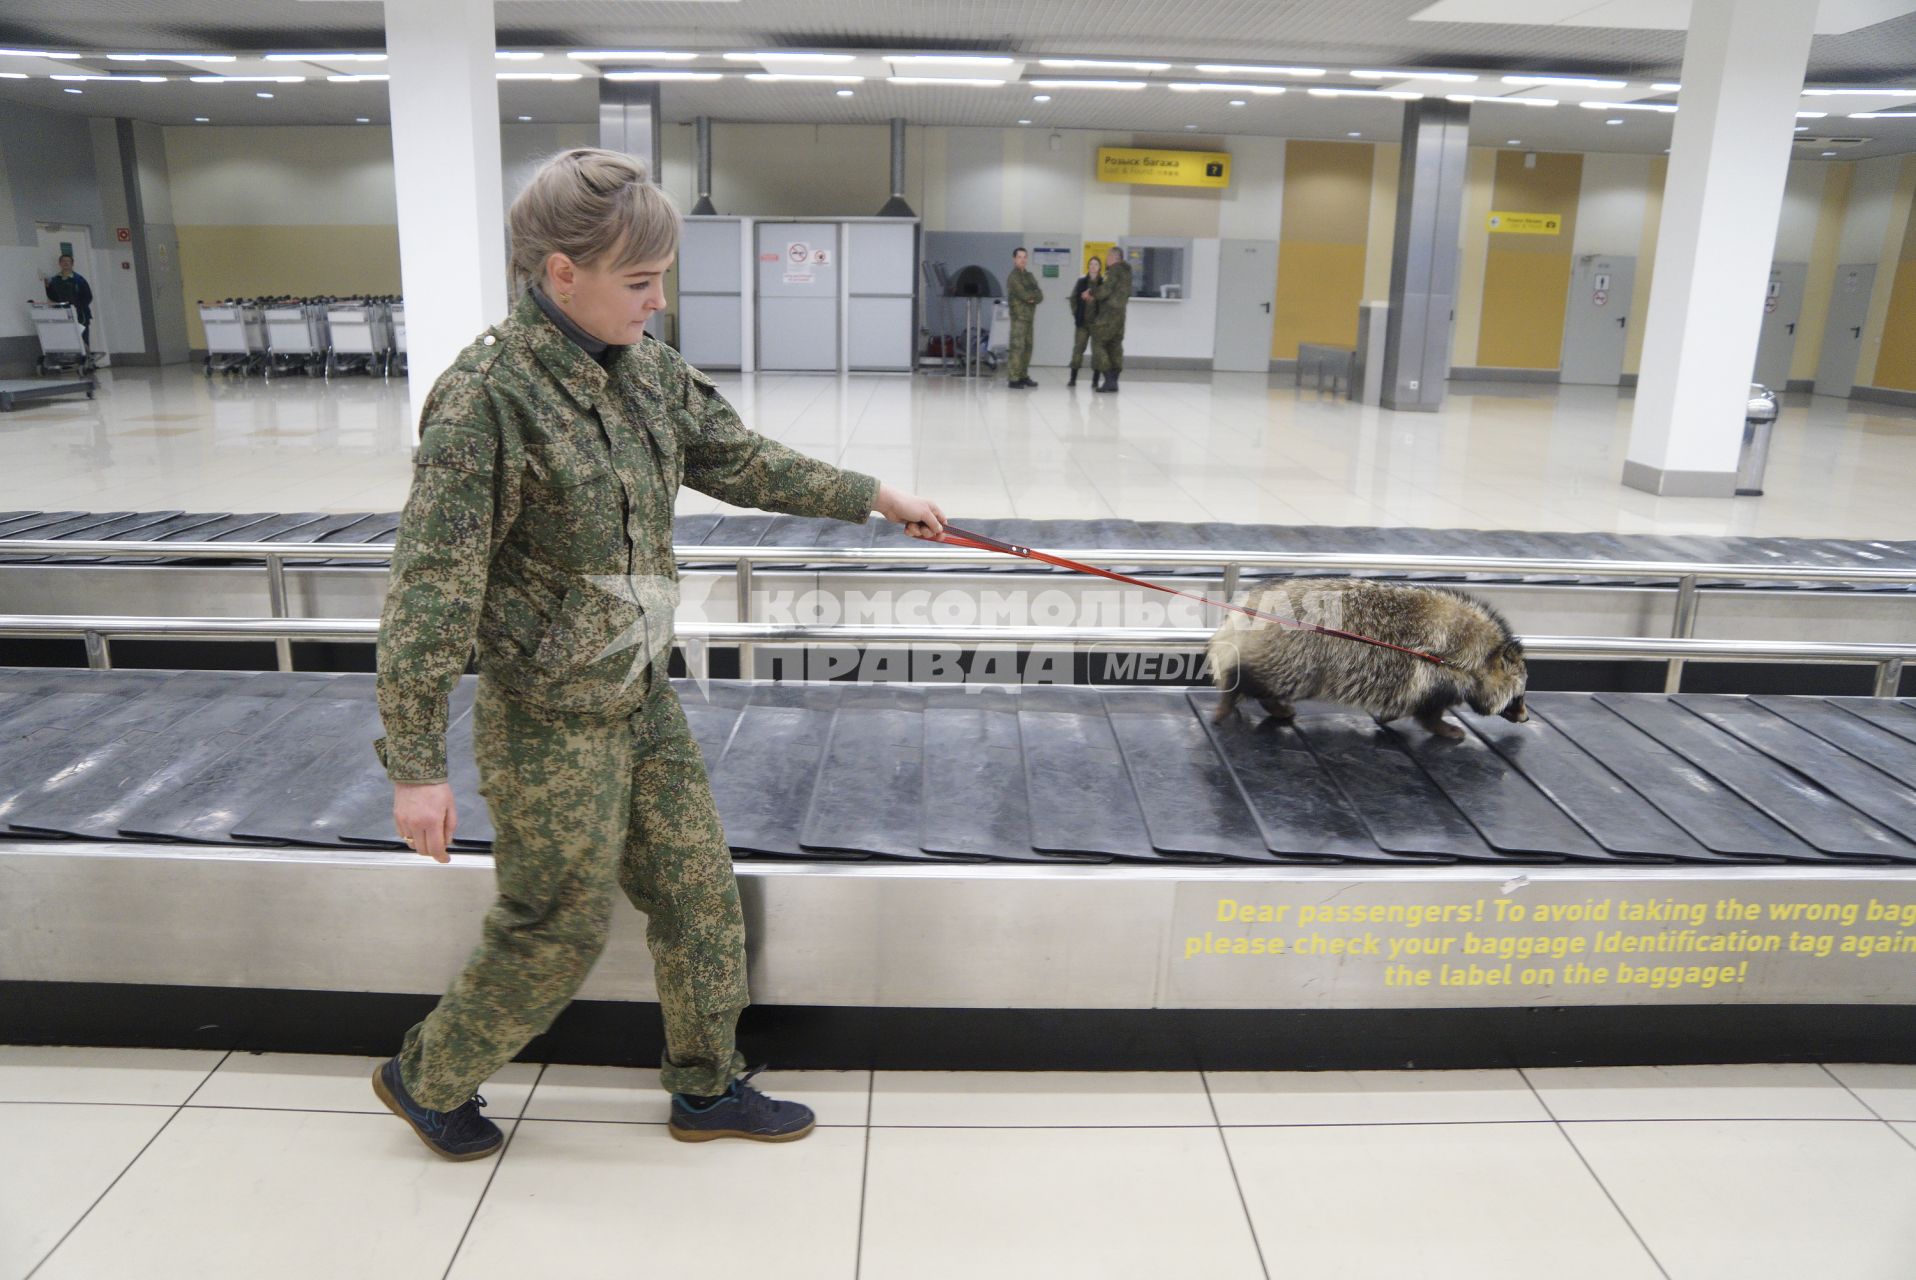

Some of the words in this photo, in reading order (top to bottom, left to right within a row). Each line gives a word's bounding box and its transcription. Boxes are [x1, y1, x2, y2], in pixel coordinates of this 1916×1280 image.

[1105, 156, 1139, 166] Розыск
[1143, 157, 1180, 167] багажа
[1216, 898, 1291, 923] Dear
[1297, 898, 1485, 929] passengers!
[1494, 898, 1527, 923] To
[1532, 898, 1612, 923] avoid
[1617, 897, 1709, 927] taking
[1715, 897, 1762, 921] the
[1768, 902, 1861, 927] wrong
[1184, 931, 1286, 960] please
[1293, 932, 1381, 955] check
[1387, 937, 1457, 961] your
[1462, 931, 1587, 960] baggage
[1593, 929, 1782, 953] Identification
[1788, 931, 1835, 958] tag
[1384, 964, 1433, 987] the
[1439, 963, 1513, 987] label
[1520, 967, 1556, 986] on
[1563, 962, 1610, 986] the
[1616, 960, 1749, 990] baggage!
